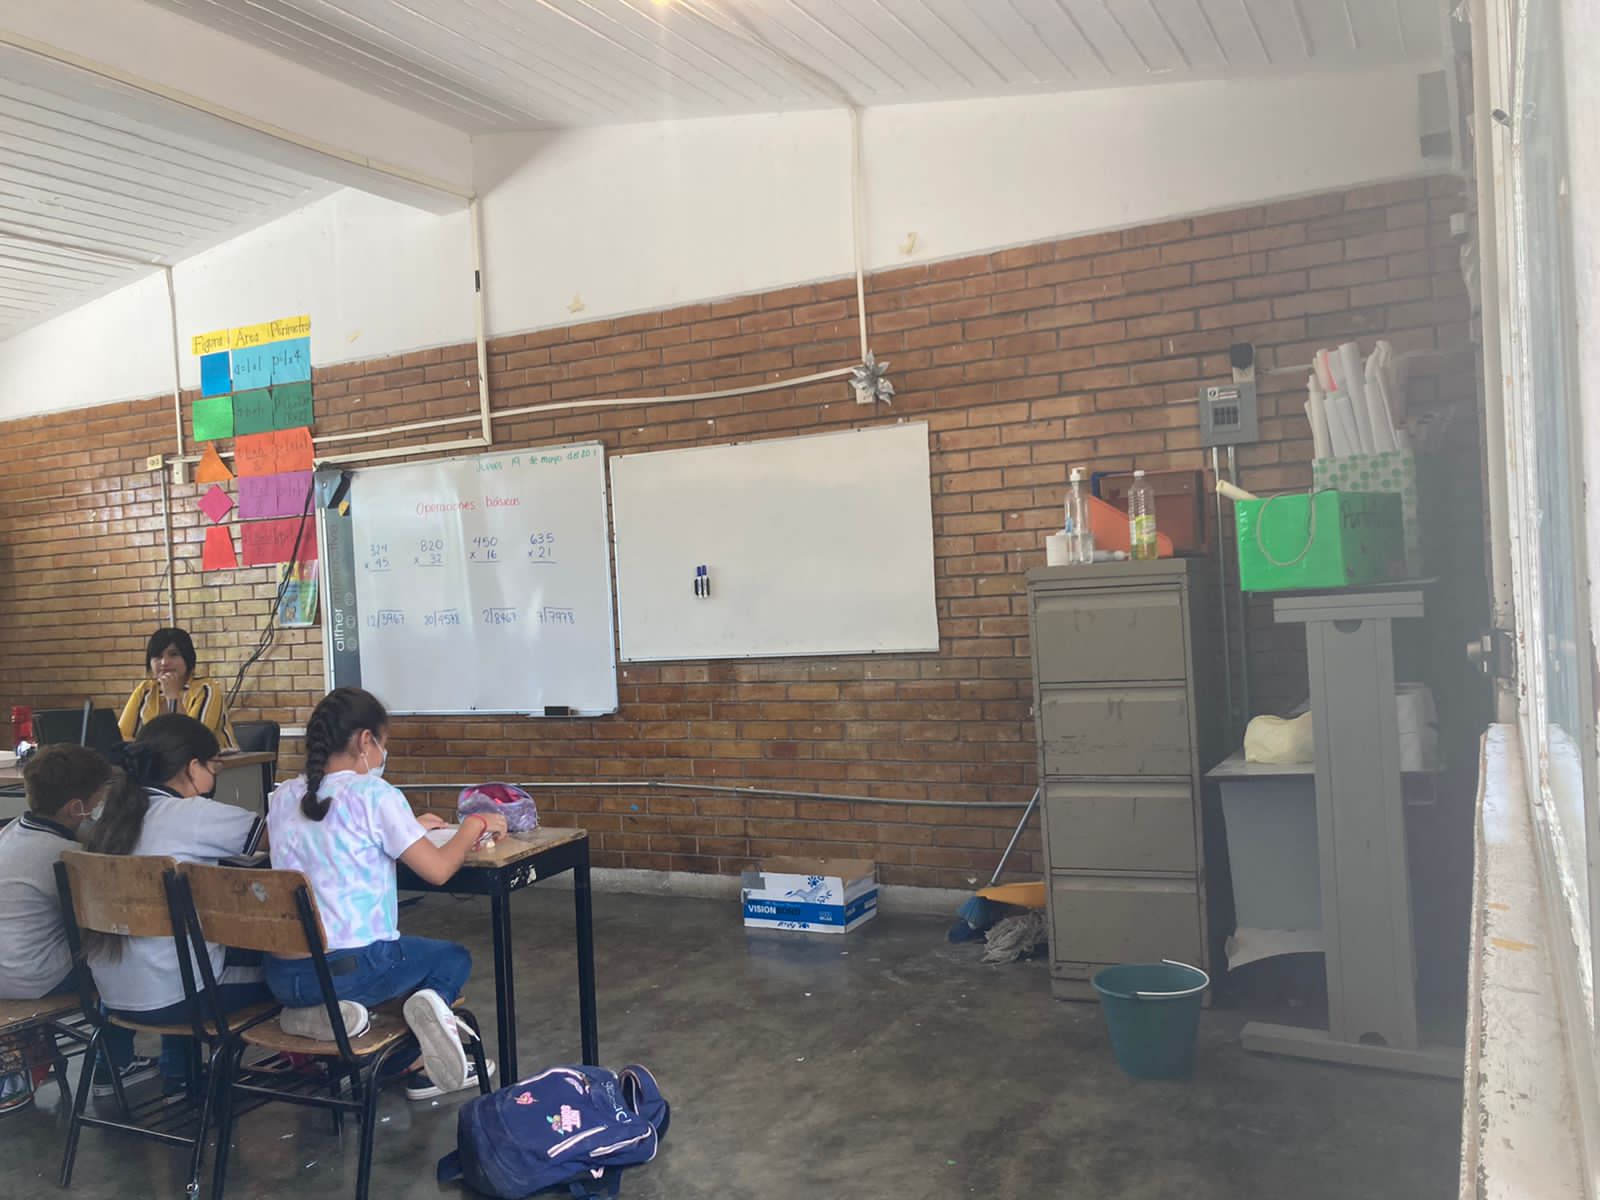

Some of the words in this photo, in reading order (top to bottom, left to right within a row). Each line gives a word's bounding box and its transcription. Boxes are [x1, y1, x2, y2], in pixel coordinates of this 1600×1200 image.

[472, 536, 498, 548] 450
[529, 533, 555, 545] 635
[420, 539, 444, 552] 820
[748, 905, 777, 915] VISION
